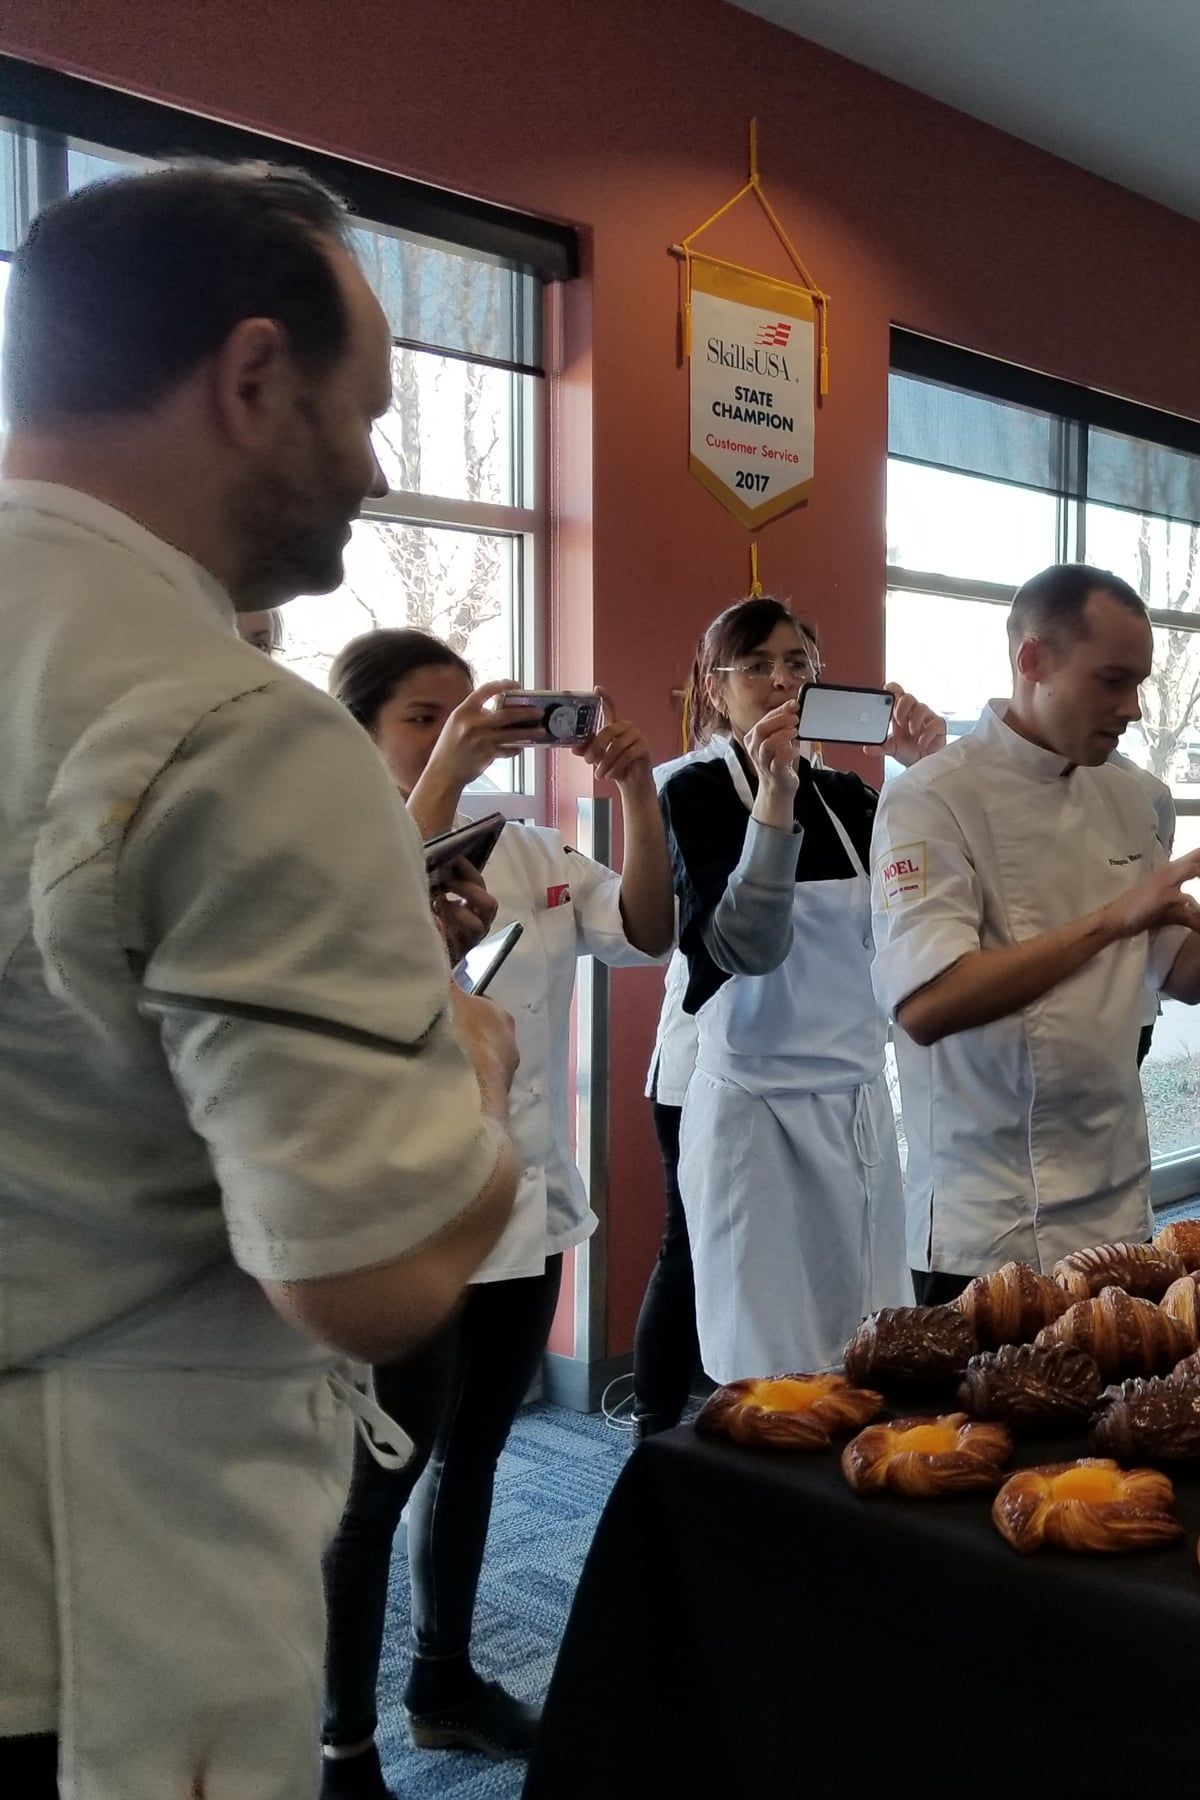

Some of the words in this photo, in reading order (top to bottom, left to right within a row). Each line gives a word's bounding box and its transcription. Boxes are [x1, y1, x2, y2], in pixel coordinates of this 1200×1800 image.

[706, 337, 792, 382] SkillsUSA
[734, 385, 773, 408] STATE
[712, 401, 794, 433] CHAMPION
[705, 433, 758, 455] Customer
[761, 444, 799, 464] Service
[735, 470, 770, 492] 2017
[883, 859, 919, 882] NOEL
